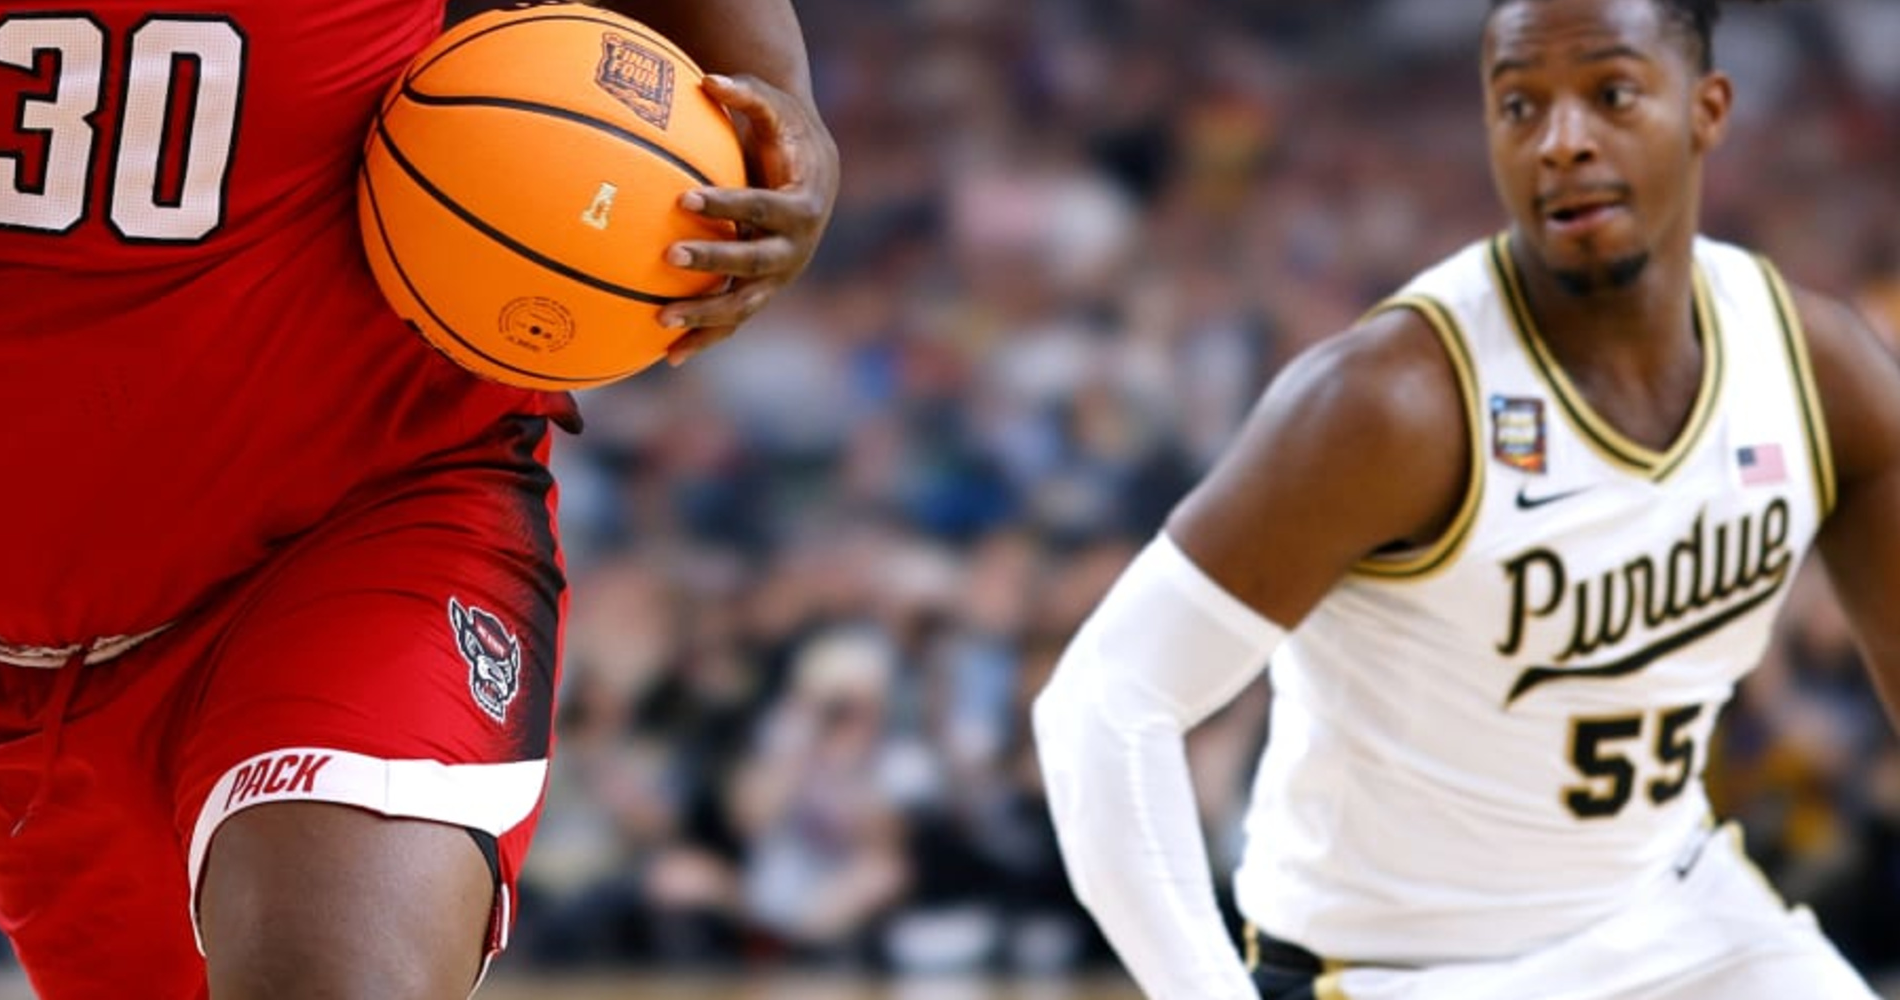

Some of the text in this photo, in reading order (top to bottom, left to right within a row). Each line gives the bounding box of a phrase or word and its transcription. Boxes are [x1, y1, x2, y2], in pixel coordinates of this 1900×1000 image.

[1496, 496, 1793, 663] Purdue
[224, 753, 332, 811] PACK
[1559, 702, 1704, 821] 55
